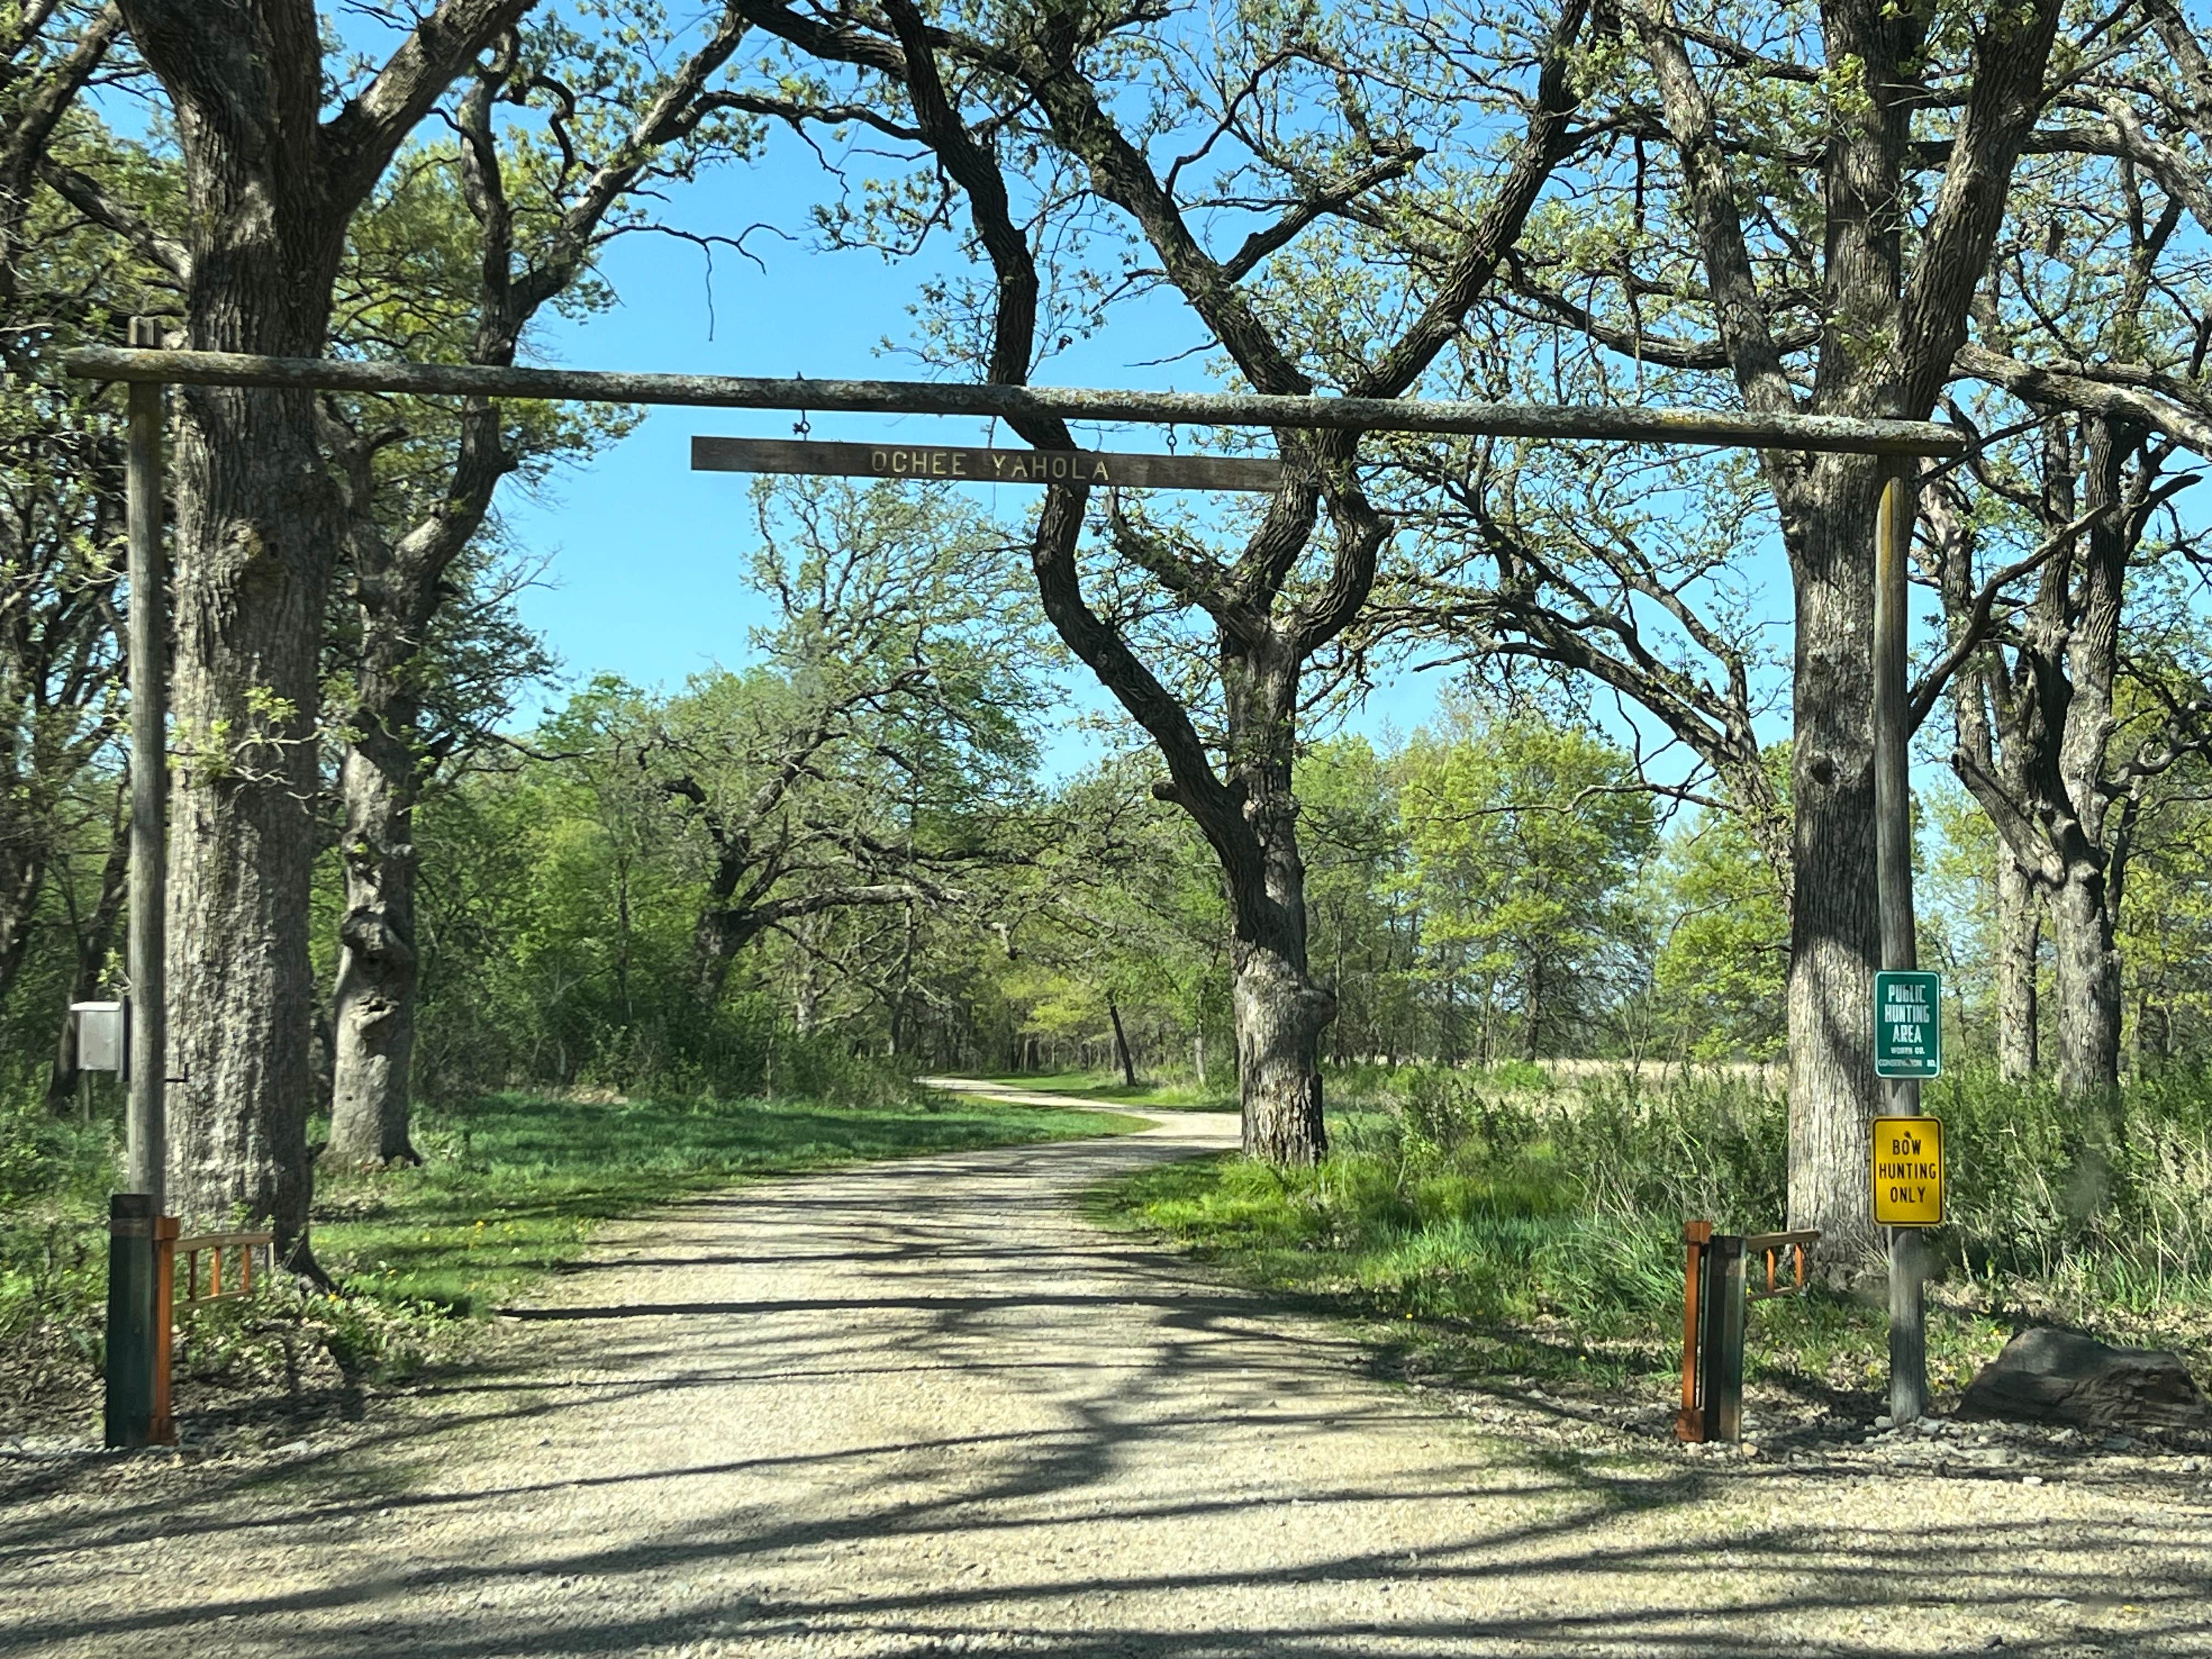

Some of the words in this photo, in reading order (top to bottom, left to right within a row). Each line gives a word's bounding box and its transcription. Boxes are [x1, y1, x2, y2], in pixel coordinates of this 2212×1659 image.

[872, 450, 968, 476] OCHEE
[991, 453, 1110, 481] YAHOLA
[1888, 984, 1926, 1003] PUBLIC
[1884, 1004, 1930, 1023] HUNTING
[1893, 1024, 1922, 1043] AREA
[1892, 1139, 1921, 1155] BOW
[1879, 1163, 1936, 1180] HUNTING
[1890, 1187, 1926, 1203] ONLY
